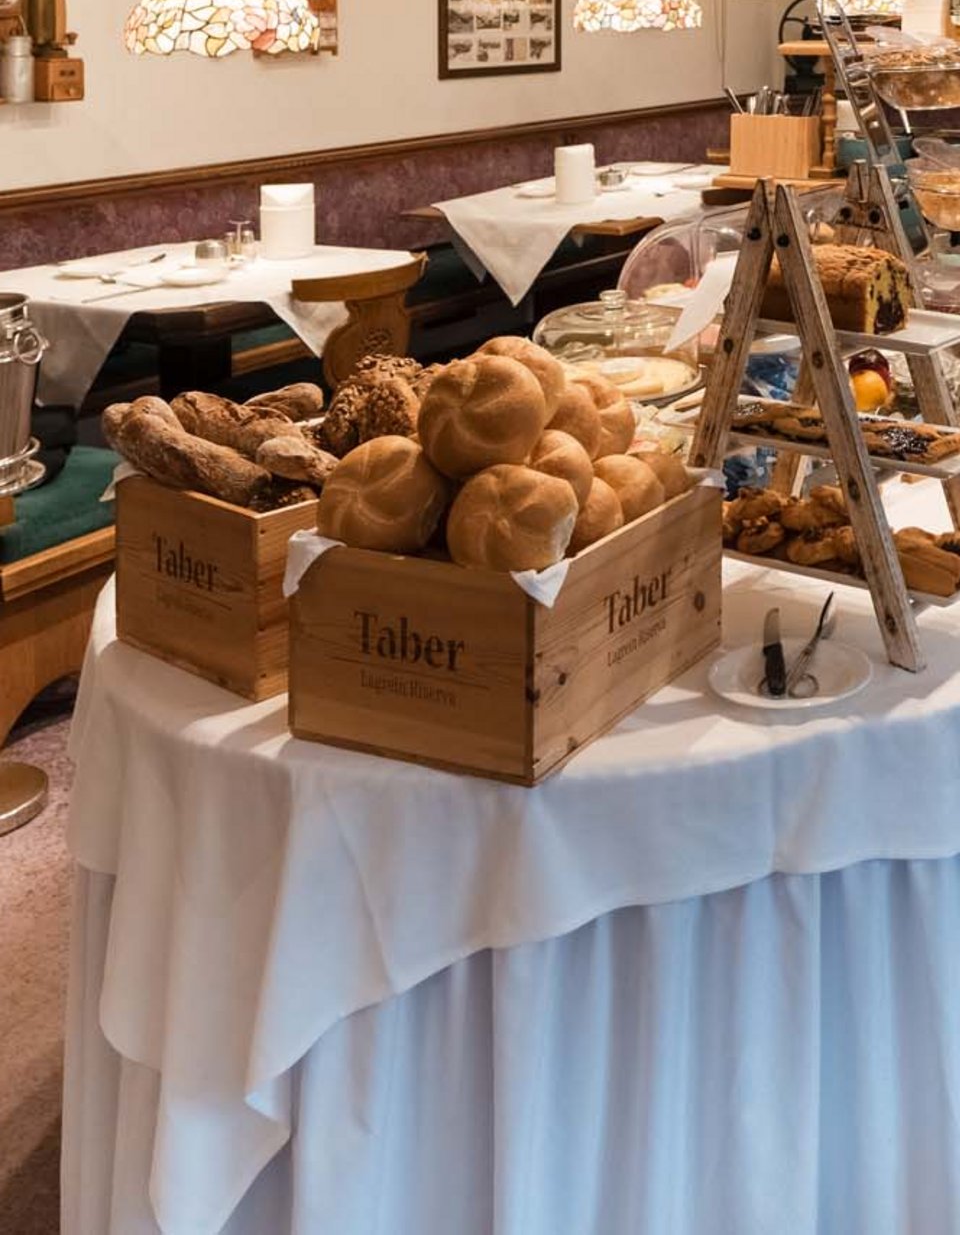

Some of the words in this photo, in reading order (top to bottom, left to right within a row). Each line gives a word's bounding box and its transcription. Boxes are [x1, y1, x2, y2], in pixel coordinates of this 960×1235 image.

[152, 531, 218, 592] Taber
[602, 567, 671, 634] Taber
[353, 610, 465, 671] Taber
